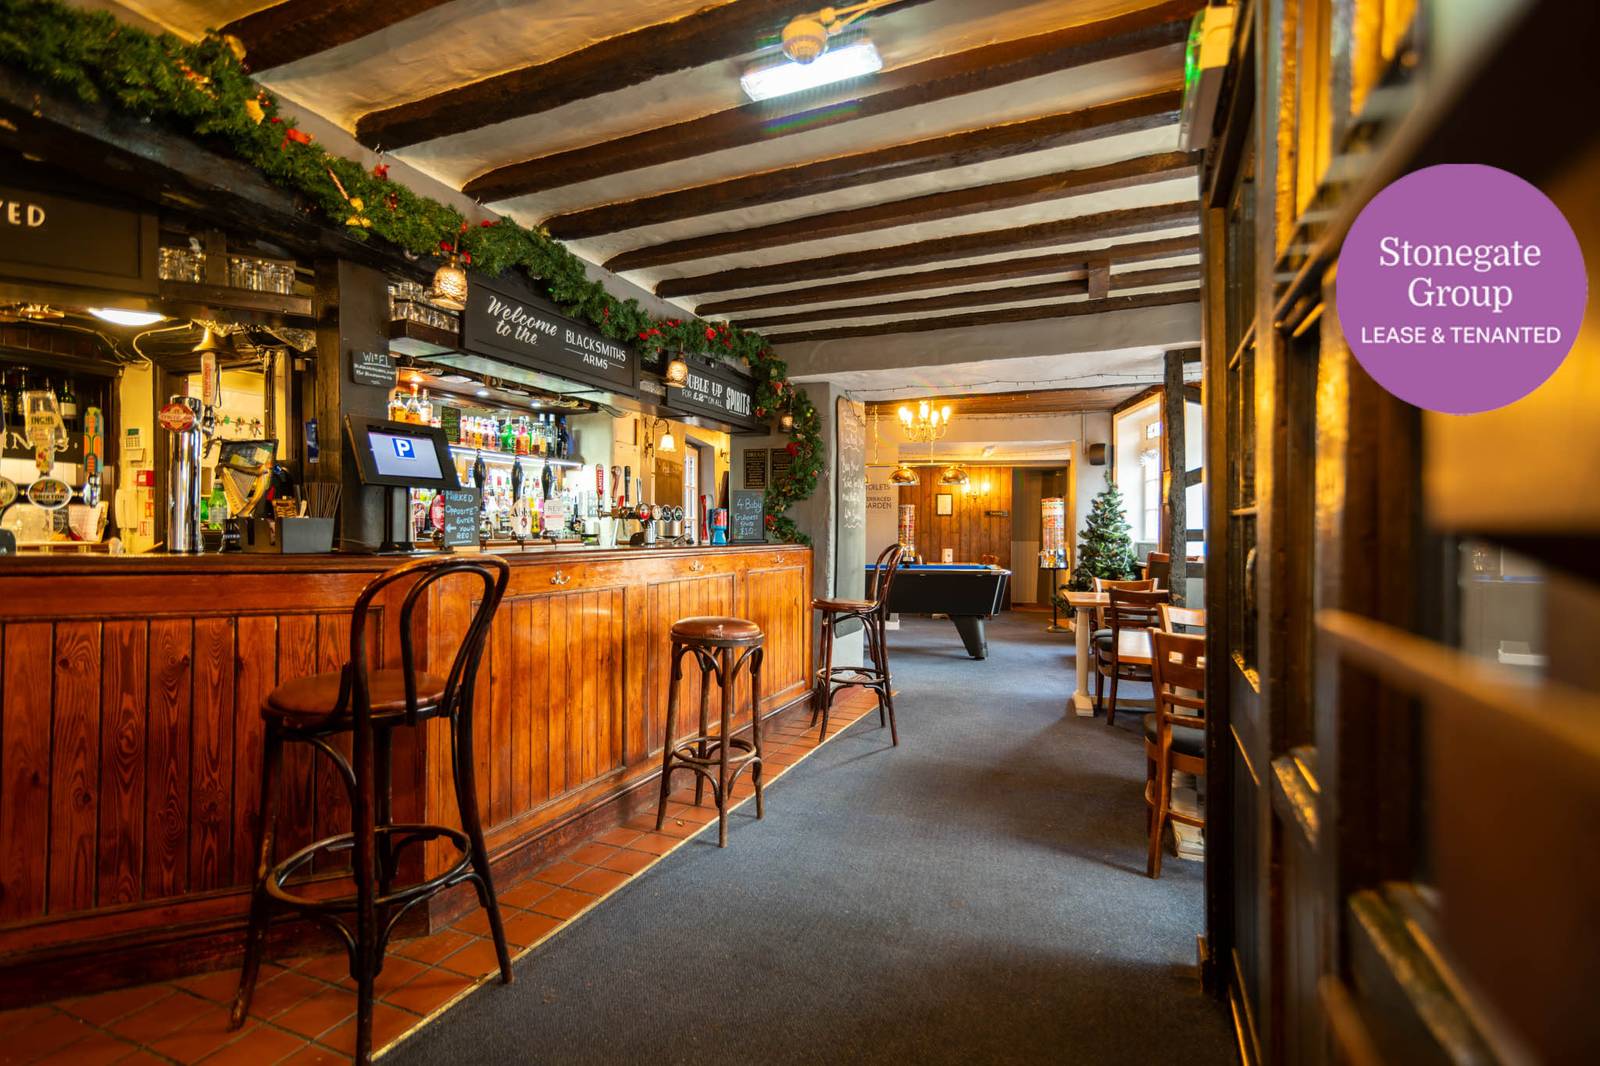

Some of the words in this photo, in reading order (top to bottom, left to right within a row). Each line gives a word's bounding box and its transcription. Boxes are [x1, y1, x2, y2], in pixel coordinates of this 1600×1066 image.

[0, 201, 46, 227] ED
[487, 295, 558, 337] Welcome
[496, 320, 512, 337] to
[514, 323, 538, 345] the
[565, 329, 626, 362] BLACKSMITHS
[583, 353, 608, 370] ARMS
[686, 373, 710, 394] UBLE
[711, 382, 723, 398] UP
